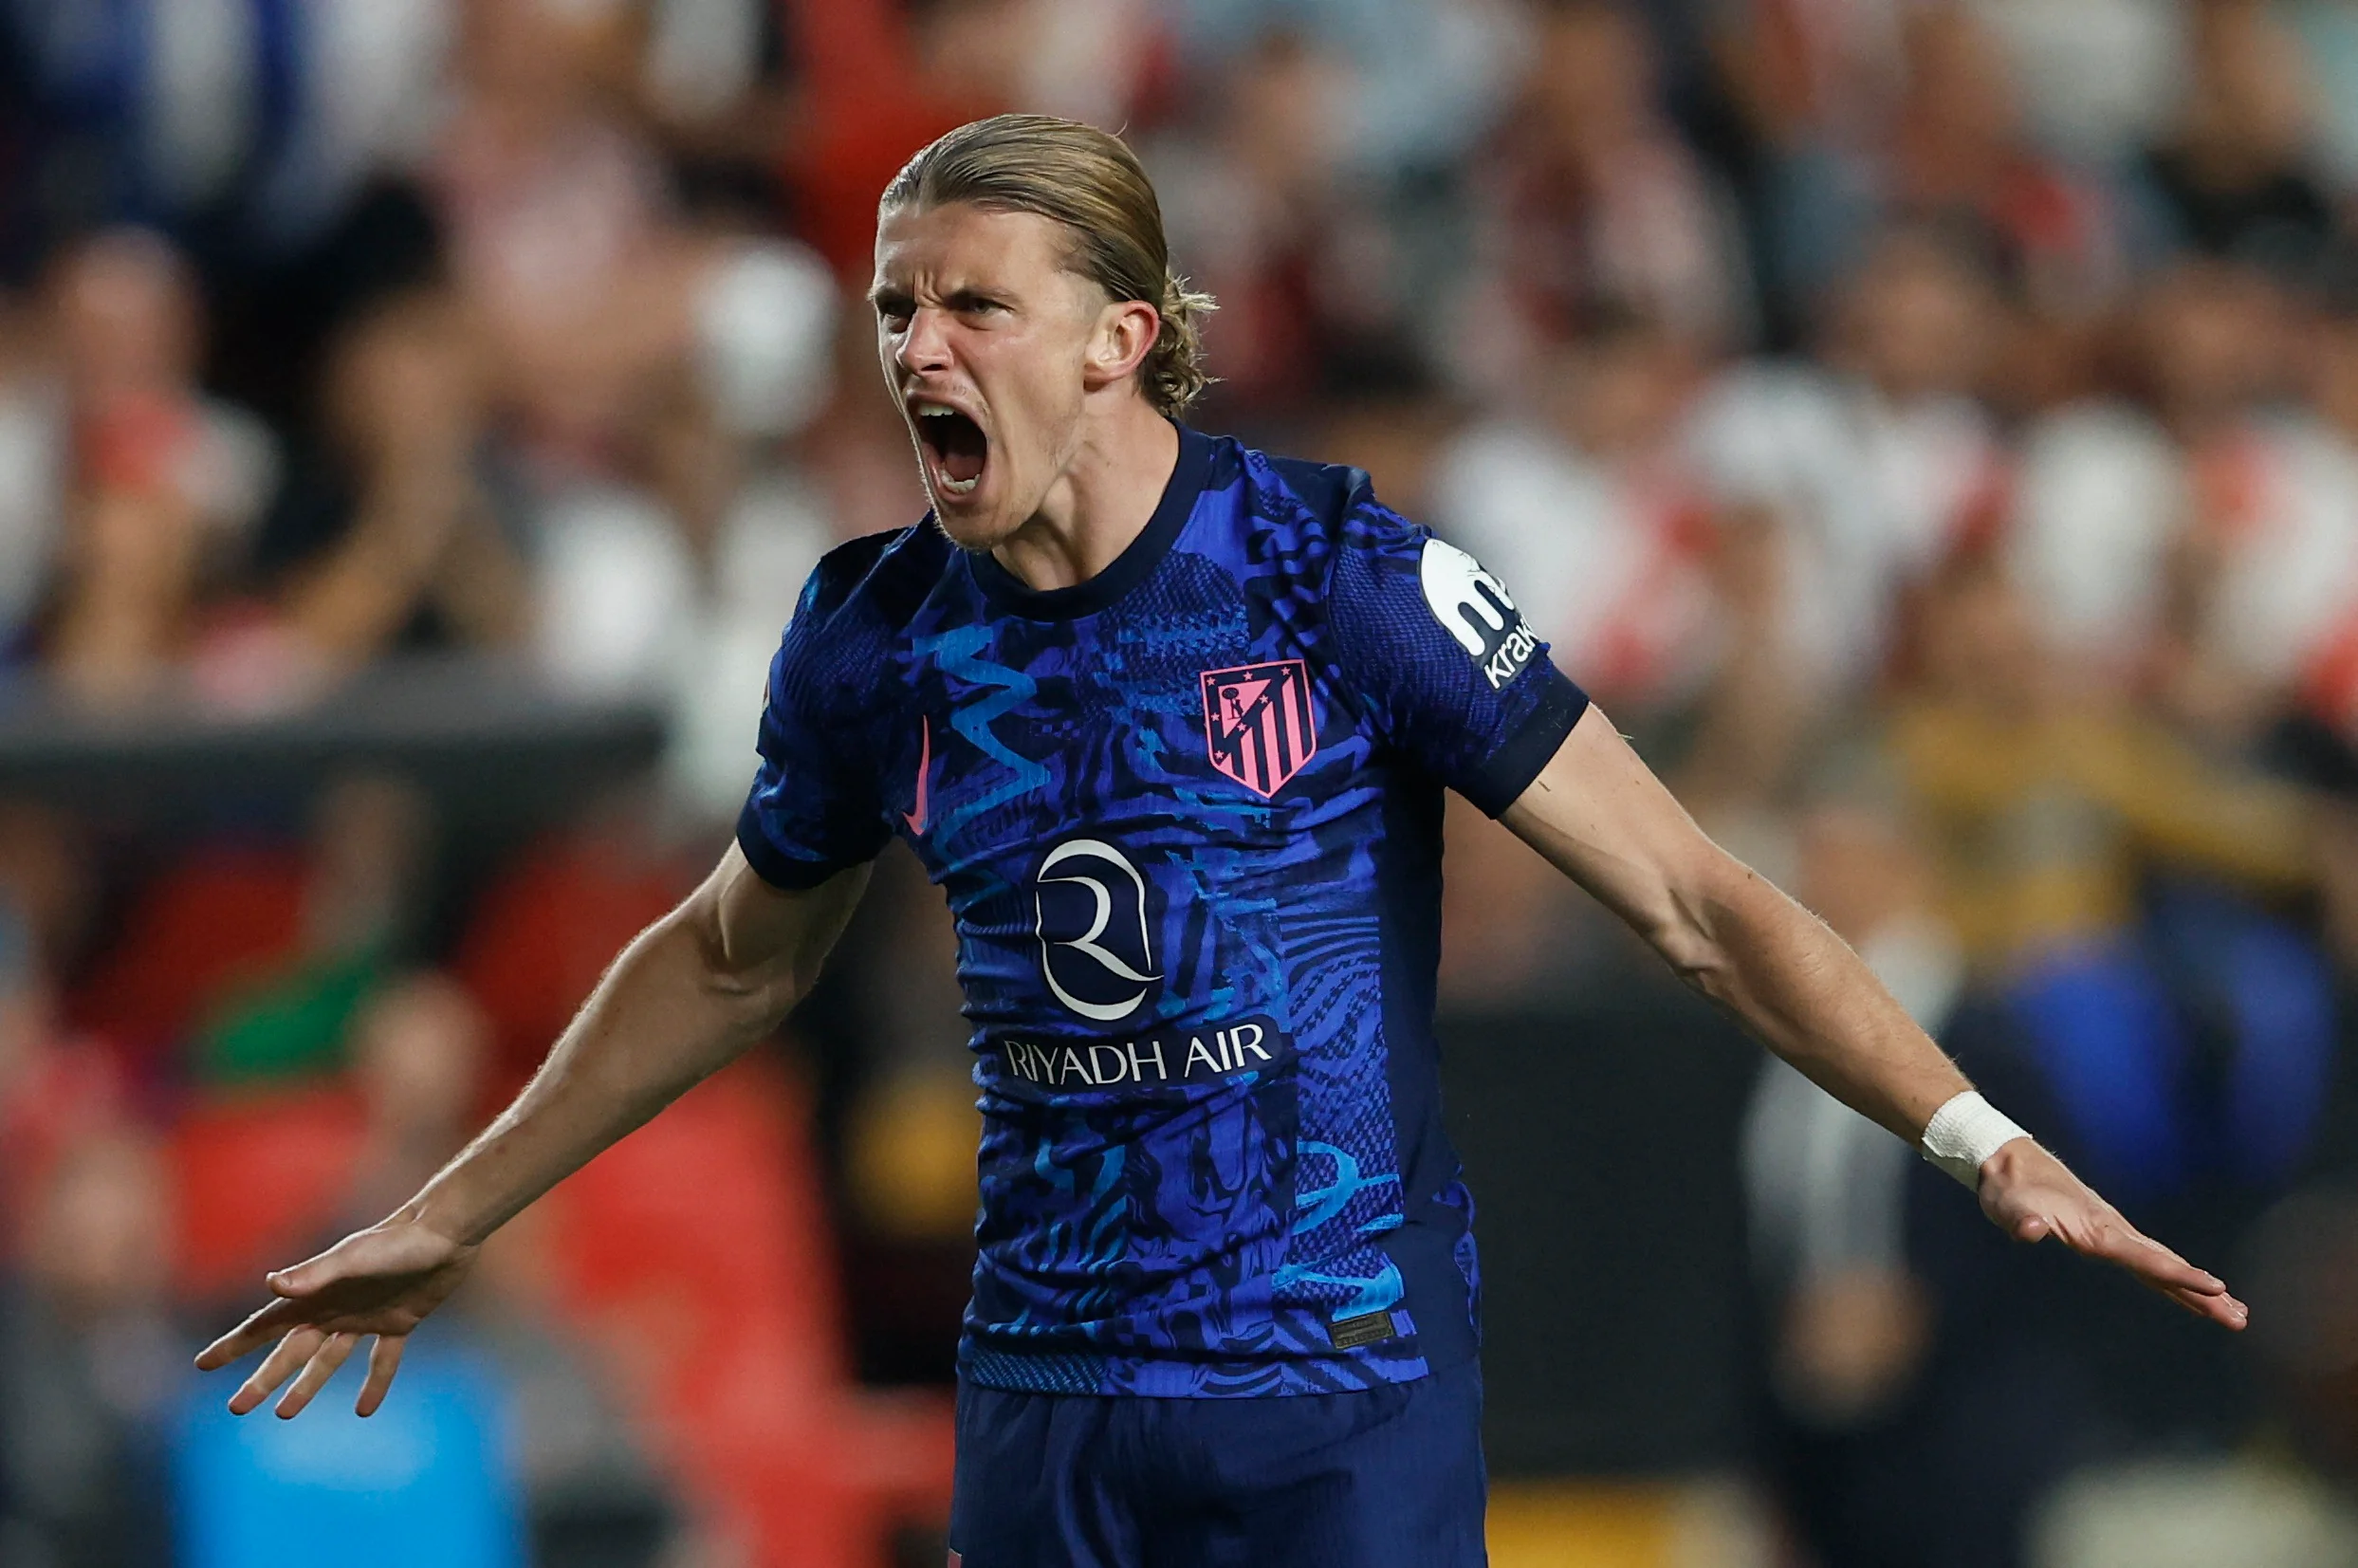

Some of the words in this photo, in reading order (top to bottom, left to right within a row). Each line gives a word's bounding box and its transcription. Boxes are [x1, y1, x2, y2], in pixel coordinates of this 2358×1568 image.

[1483, 614, 1538, 689] krak
[1004, 1040, 1168, 1085] RIYADH
[1185, 1024, 1273, 1078] AIR
